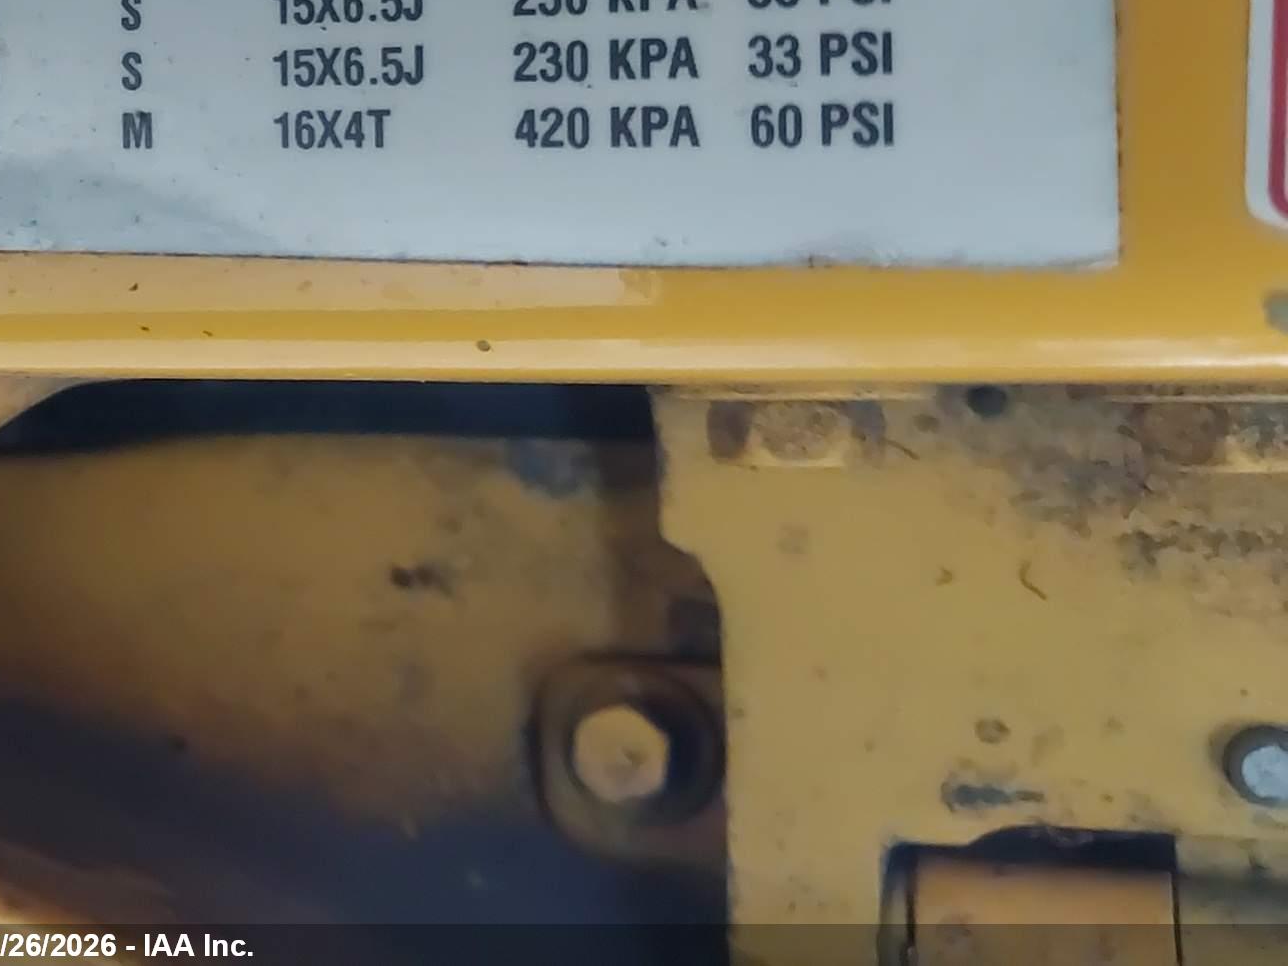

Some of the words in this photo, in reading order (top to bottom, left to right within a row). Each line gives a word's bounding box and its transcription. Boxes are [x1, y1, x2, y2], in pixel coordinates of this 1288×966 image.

[122, 52, 142, 90] S
[273, 45, 423, 87] 15X6.5J
[514, 40, 588, 82] 230
[610, 37, 699, 80] KPA
[749, 34, 801, 78] 33
[820, 31, 892, 76] PSI
[123, 111, 152, 149] M
[274, 109, 391, 149] 16X4T
[515, 107, 589, 149] 420
[610, 106, 700, 147] KPA
[751, 104, 802, 148] 60
[821, 101, 893, 147] PSI
